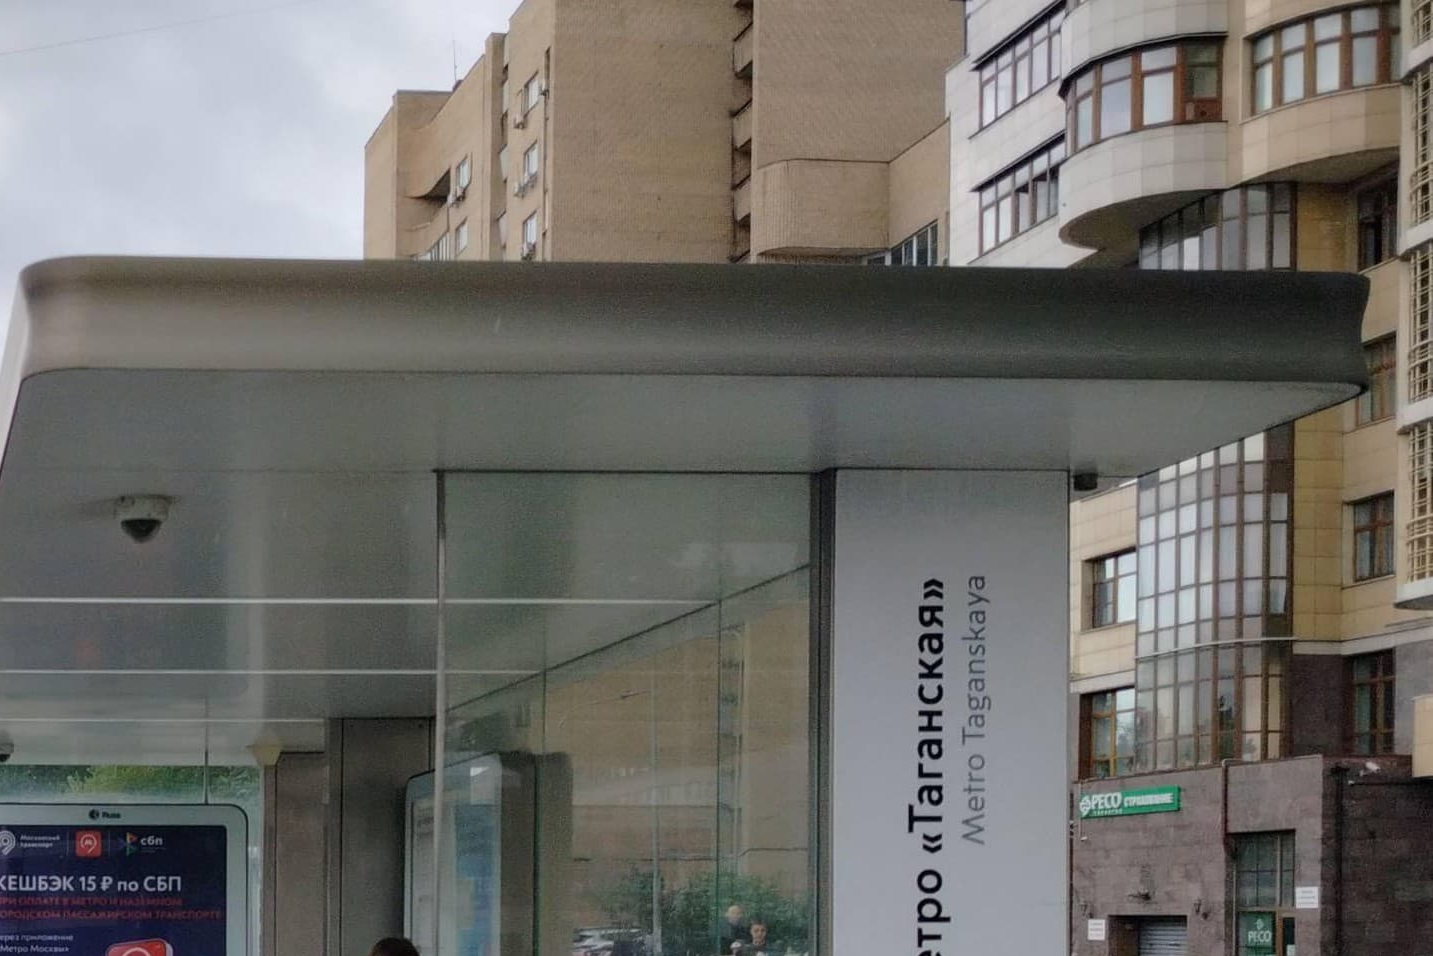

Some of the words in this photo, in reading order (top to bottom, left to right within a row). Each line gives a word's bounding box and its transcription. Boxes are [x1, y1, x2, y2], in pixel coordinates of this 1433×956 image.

[961, 574, 991, 746] Taganskaya
[908, 577, 944, 855] «Таганская»
[140, 836, 164, 847] сбп
[961, 753, 986, 845] Metro
[79, 875, 97, 892] 15
[117, 879, 140, 892] по
[143, 875, 182, 892] СБП
